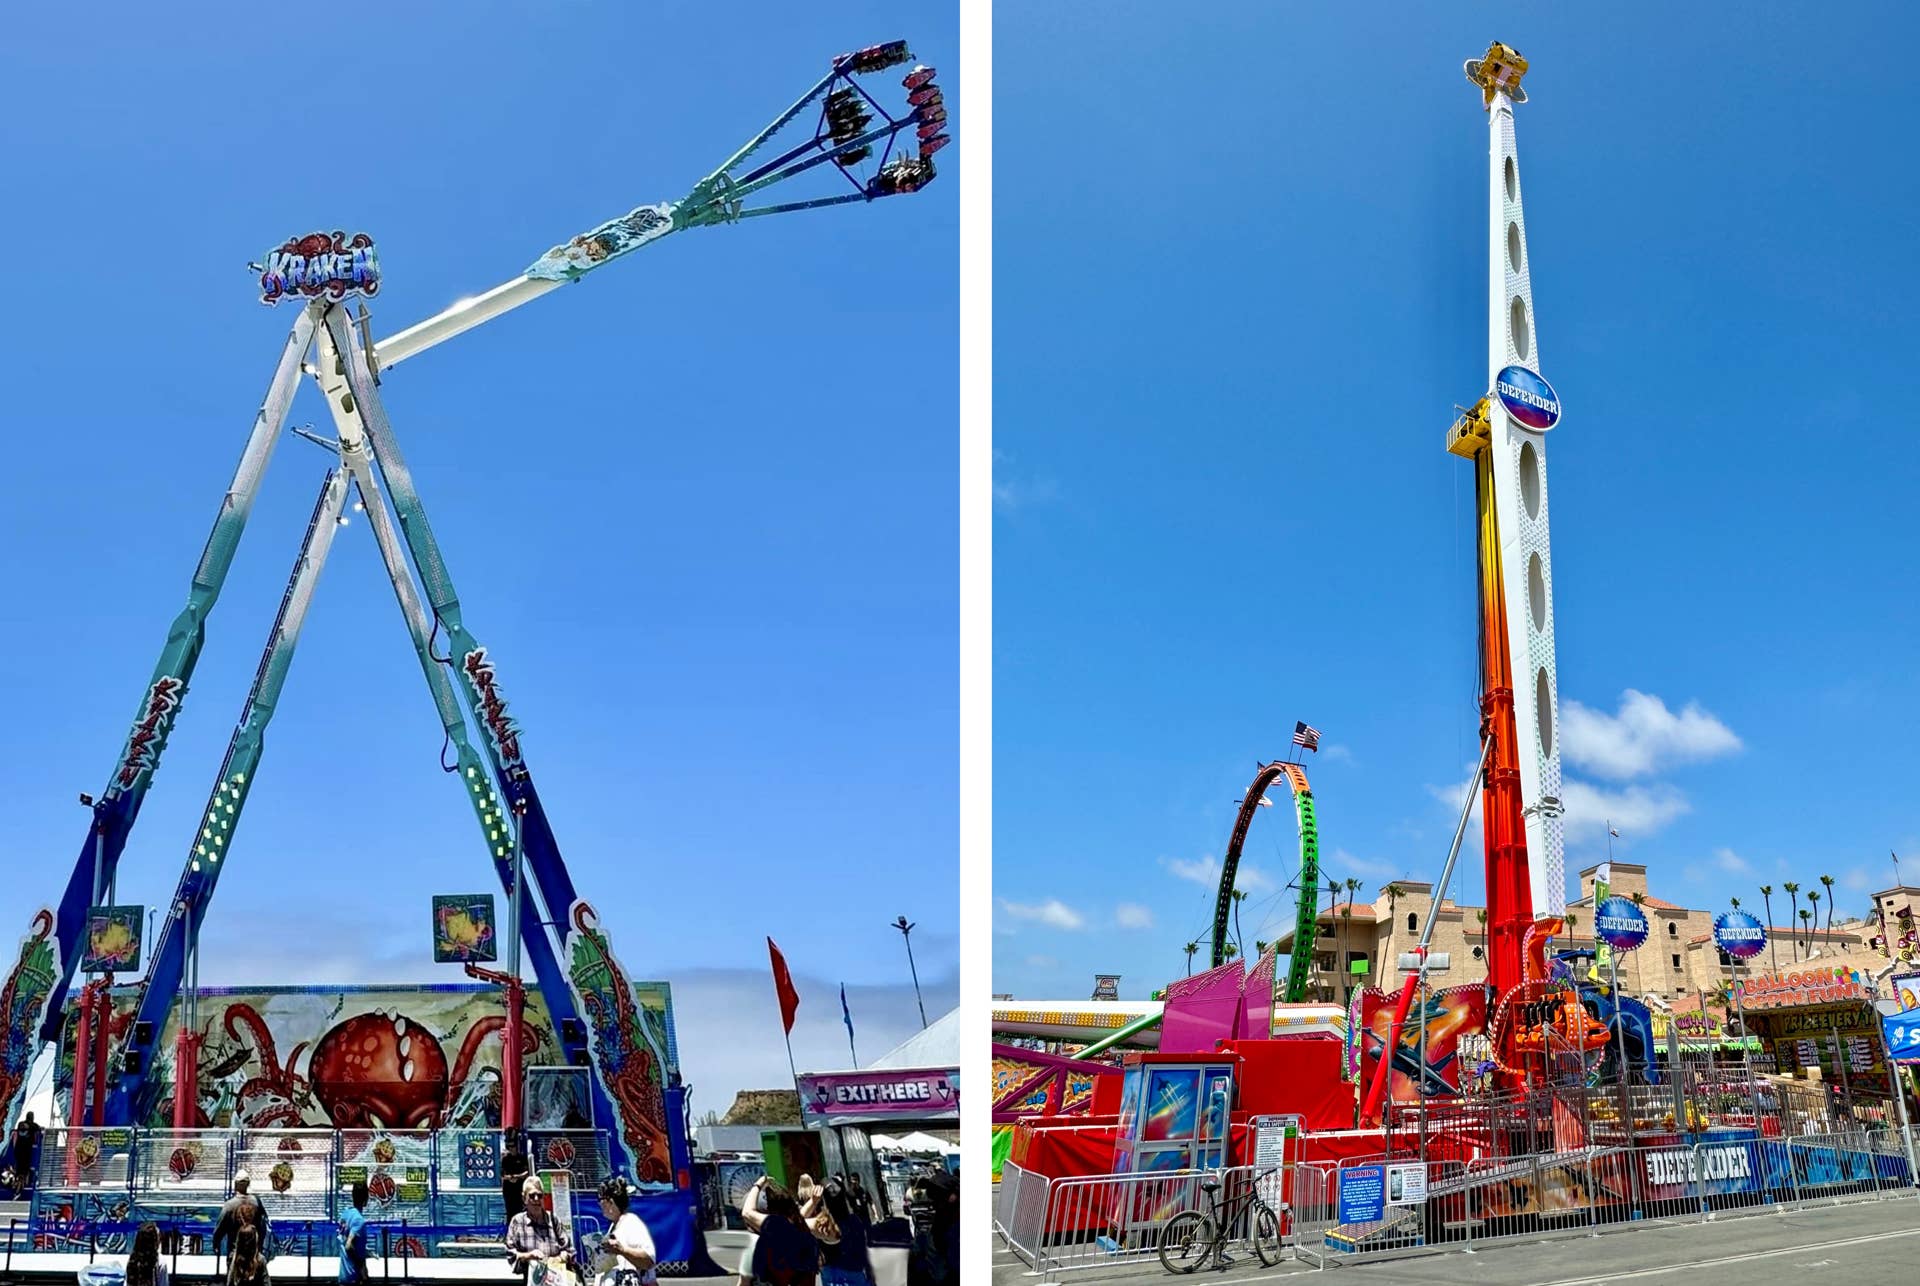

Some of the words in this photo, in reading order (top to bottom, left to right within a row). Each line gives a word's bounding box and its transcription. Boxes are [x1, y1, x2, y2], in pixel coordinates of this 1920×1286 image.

[265, 245, 377, 293] KRAKEN
[1501, 381, 1558, 415] DEFENDER
[1602, 916, 1645, 933] DEFENDER
[1721, 928, 1764, 940] DEFENDER
[1743, 967, 1833, 995] BALLOON
[1808, 983, 1860, 1003] FUN!
[1784, 1013, 1818, 1031] PRIZE
[1822, 1010, 1859, 1027] EVERY
[836, 1084, 876, 1102] EXIT
[879, 1082, 930, 1100] HERE
[1345, 1168, 1380, 1179] WARNING
